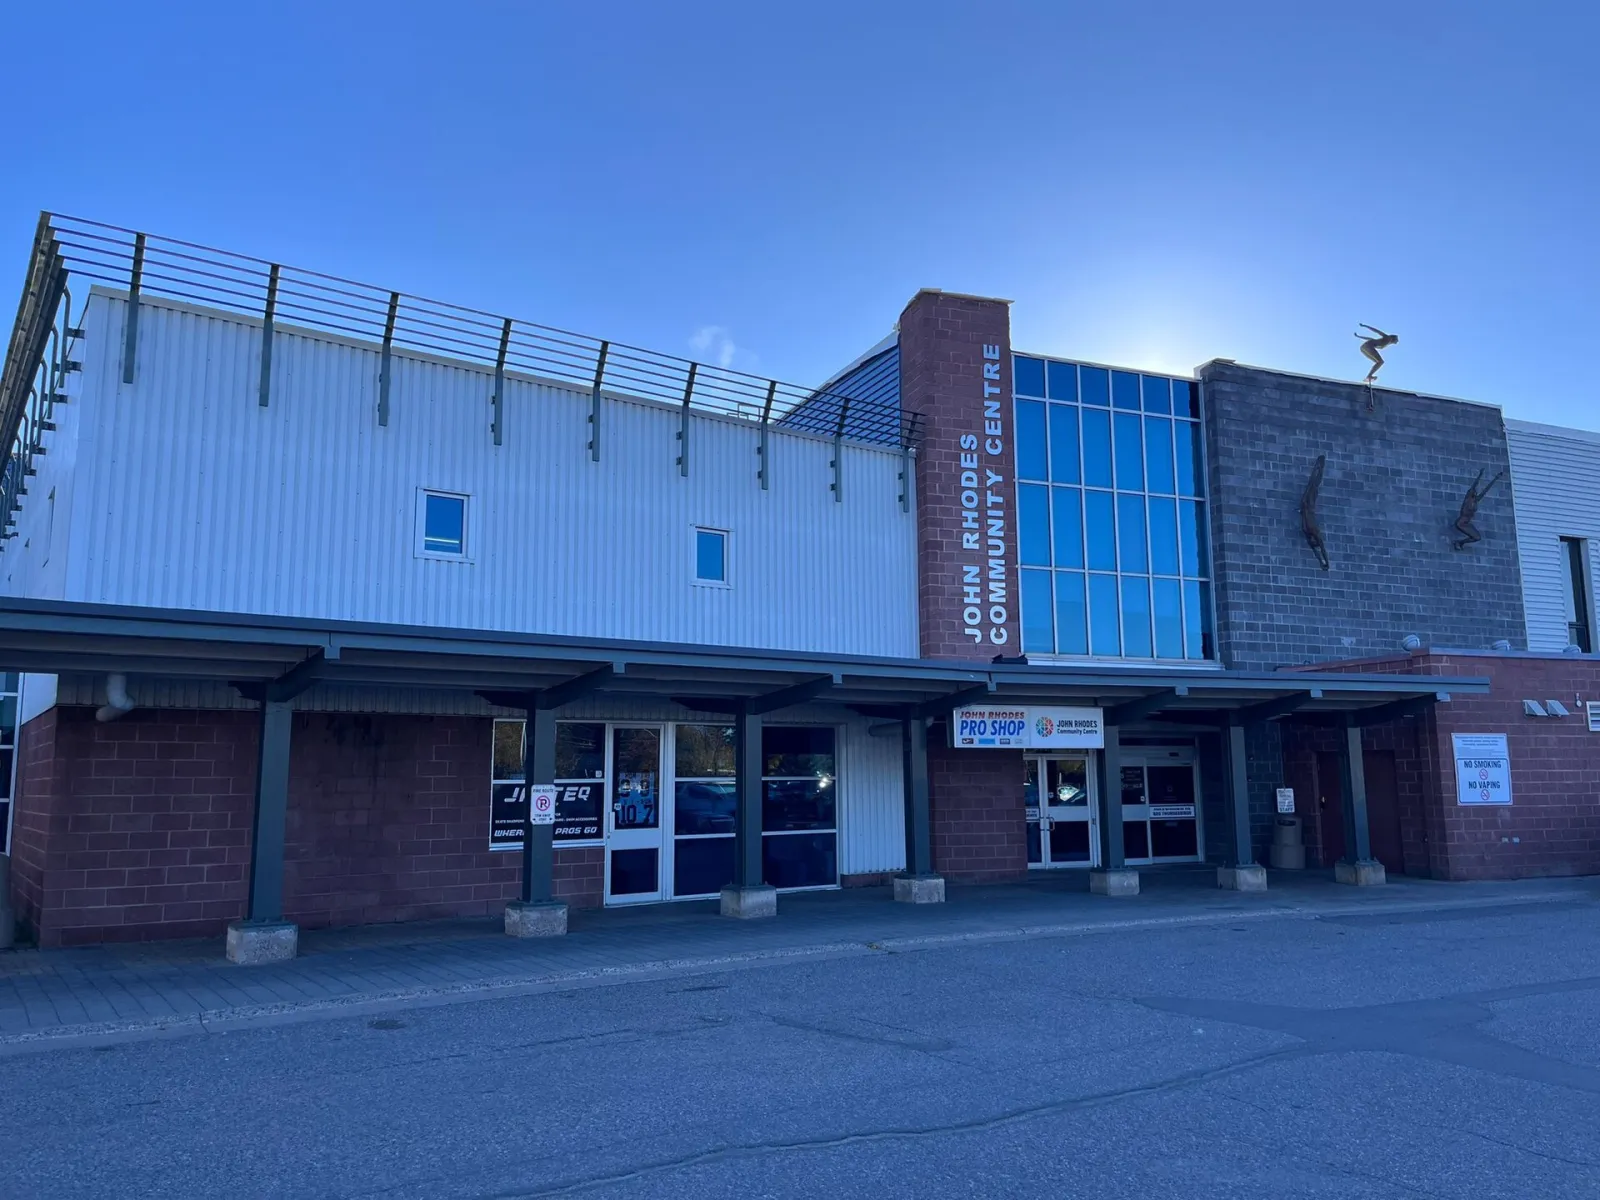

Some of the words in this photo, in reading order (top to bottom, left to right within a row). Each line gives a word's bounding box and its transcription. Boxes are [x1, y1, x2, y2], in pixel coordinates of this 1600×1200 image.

[983, 344, 1004, 456] CENTRE
[959, 433, 980, 550] RHODES
[985, 469, 1008, 645] COMMUNITY
[962, 565, 982, 644] JOHN
[959, 711, 985, 719] JOHN
[988, 711, 1025, 719] RHODES
[959, 720, 987, 736] PRO
[990, 720, 1026, 736] SHOP
[1056, 719, 1074, 728] JOHN
[1074, 719, 1098, 728] RHODES
[1463, 760, 1473, 768] NO
[1474, 760, 1502, 768] SMOKING
[1468, 781, 1477, 789] NO
[1478, 781, 1501, 789] VAPING
[555, 827, 582, 835] PROS
[583, 826, 598, 834] GO
